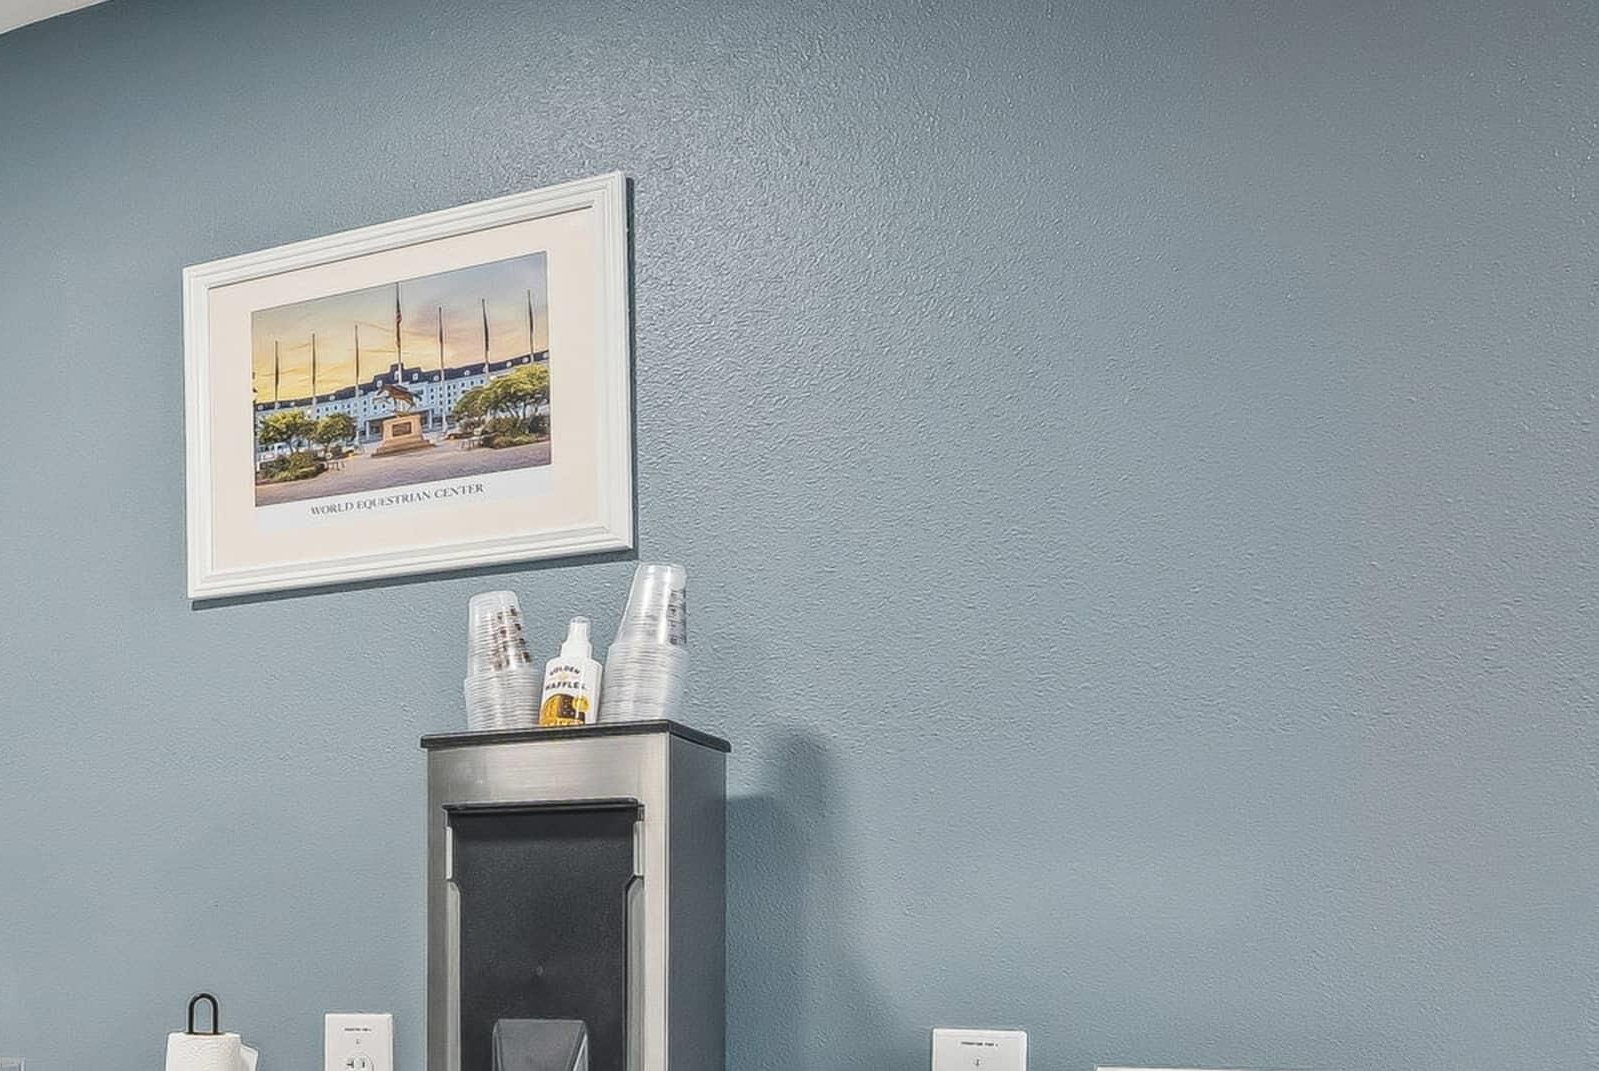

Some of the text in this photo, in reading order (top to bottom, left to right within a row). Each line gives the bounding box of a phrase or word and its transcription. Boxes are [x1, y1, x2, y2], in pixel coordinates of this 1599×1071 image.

[310, 483, 484, 516] WORLD EQUESTRIAN CENTER
